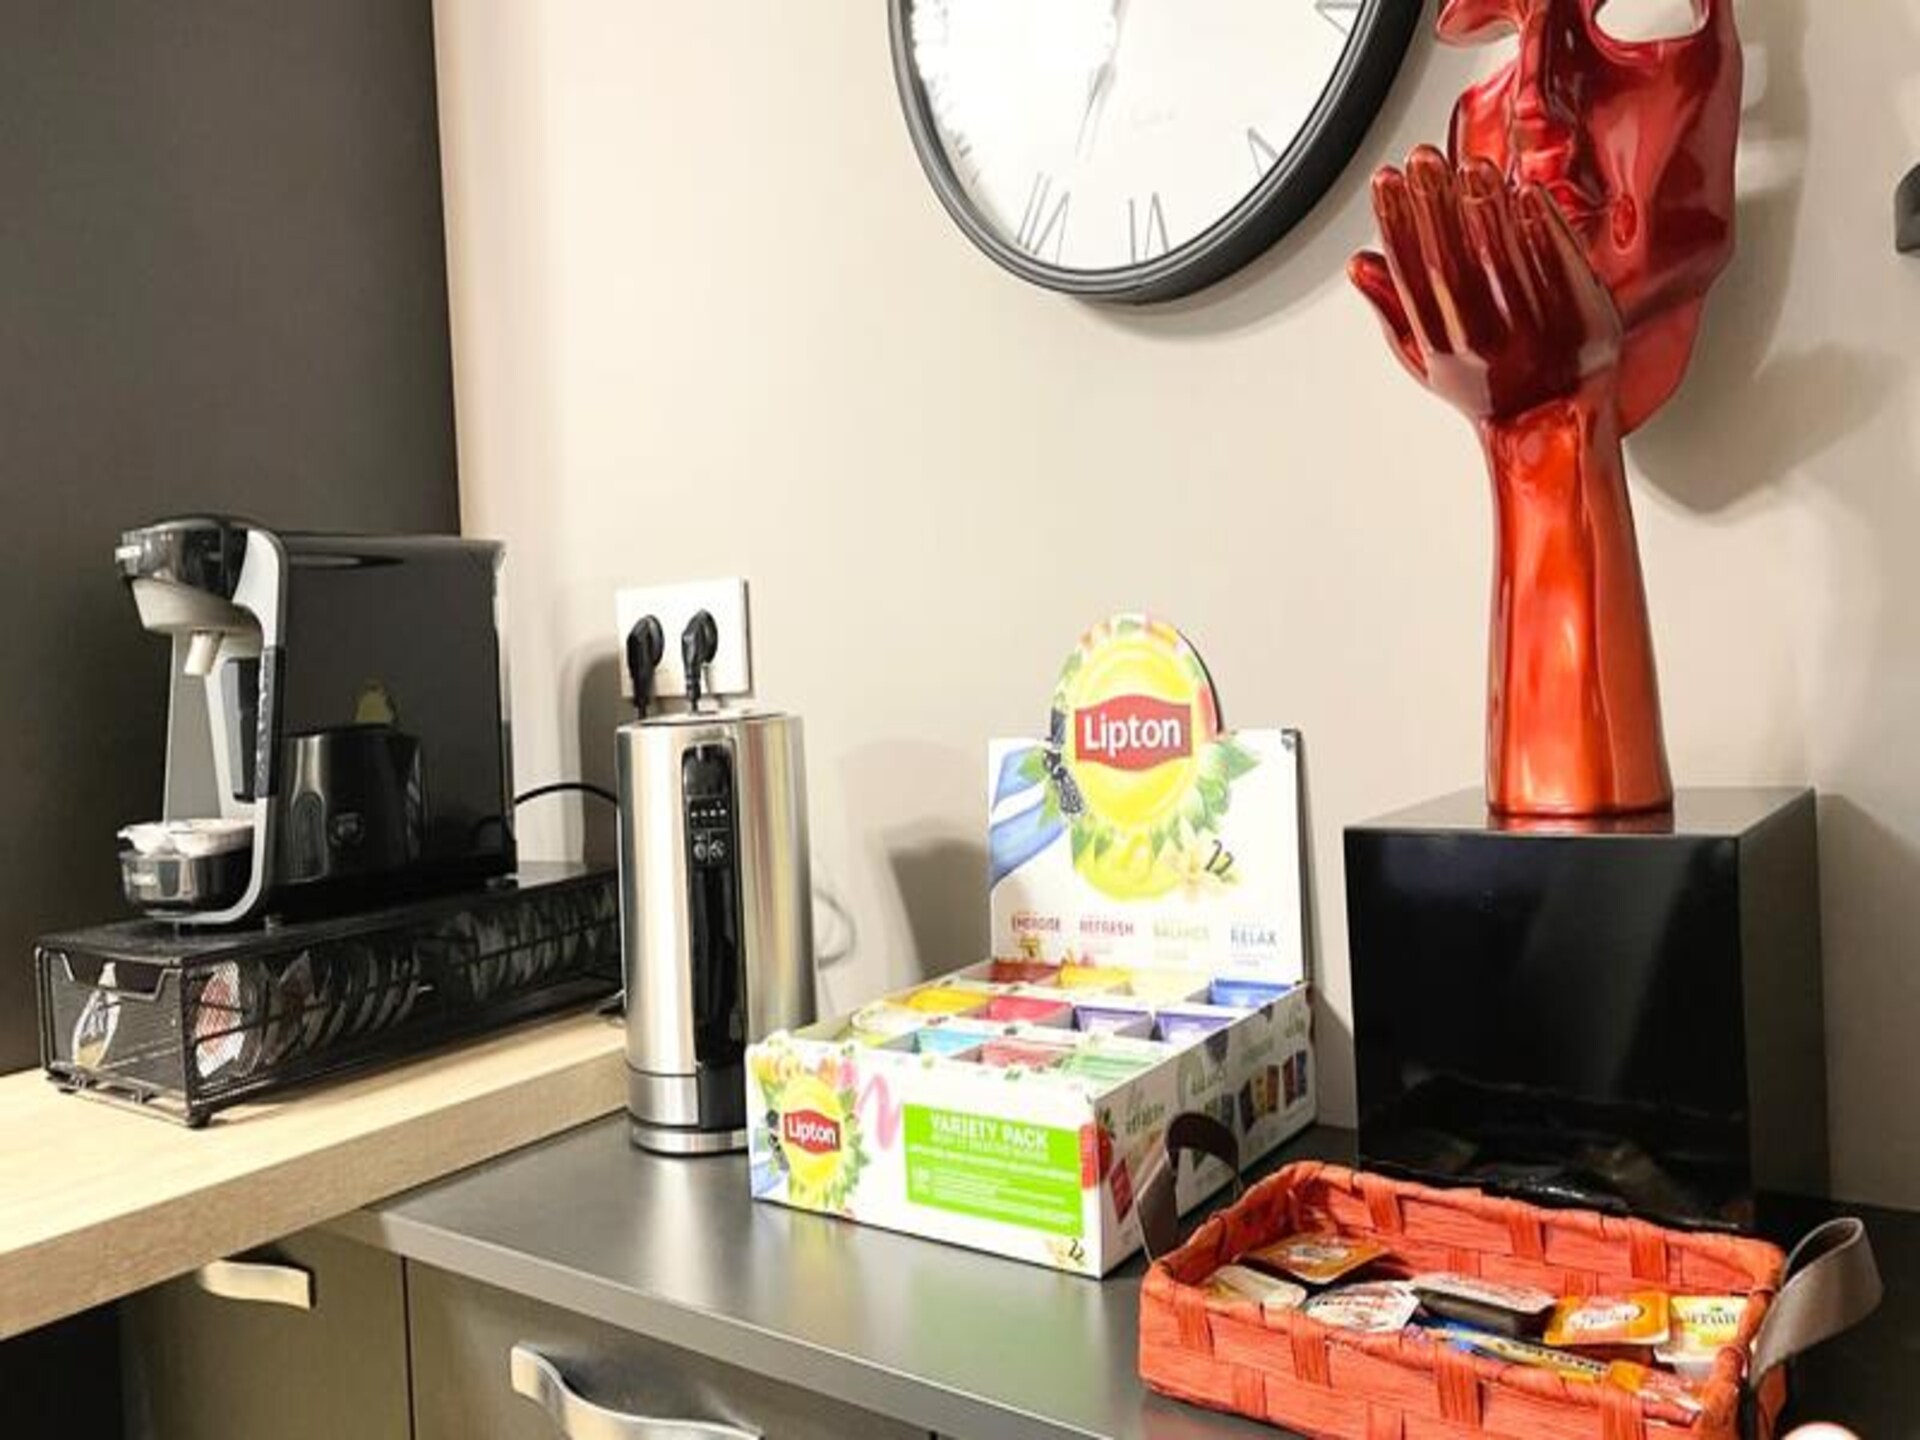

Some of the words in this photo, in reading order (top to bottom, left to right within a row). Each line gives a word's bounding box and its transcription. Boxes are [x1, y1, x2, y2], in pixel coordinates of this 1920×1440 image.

[1084, 713, 1181, 758] Lipton
[1079, 919, 1134, 937] REFRESH
[1230, 928, 1277, 947] RELAX
[788, 1116, 836, 1146] Lipton
[932, 1113, 997, 1139] VARIETY
[1003, 1125, 1048, 1148] PACK
